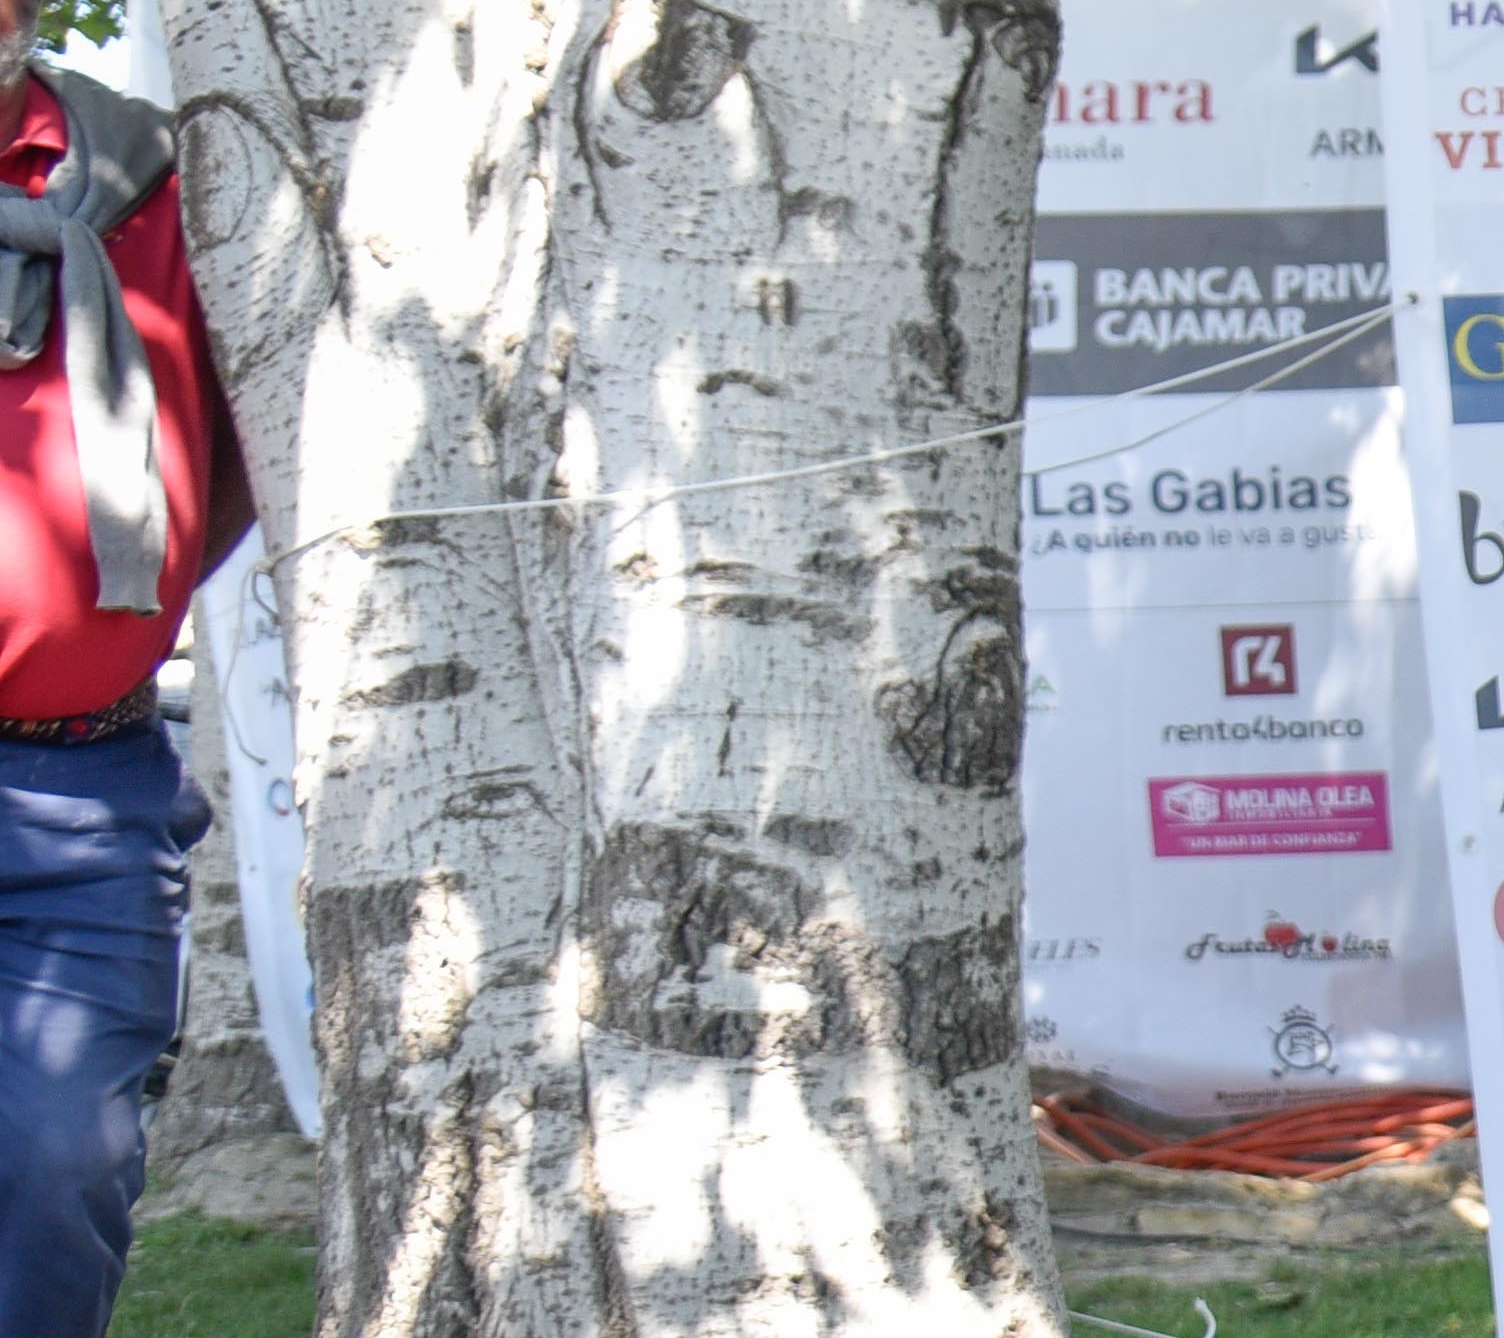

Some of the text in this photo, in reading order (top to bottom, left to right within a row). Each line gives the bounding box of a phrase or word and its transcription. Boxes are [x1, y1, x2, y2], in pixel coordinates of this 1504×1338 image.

[1093, 266, 1260, 305] BANCA
[1093, 306, 1304, 352] CAJAMAR
[1031, 464, 1352, 517] Las Gabias
[1075, 526, 1296, 553] quién no le va a
[1226, 786, 1374, 811] MOLINA OLEA
